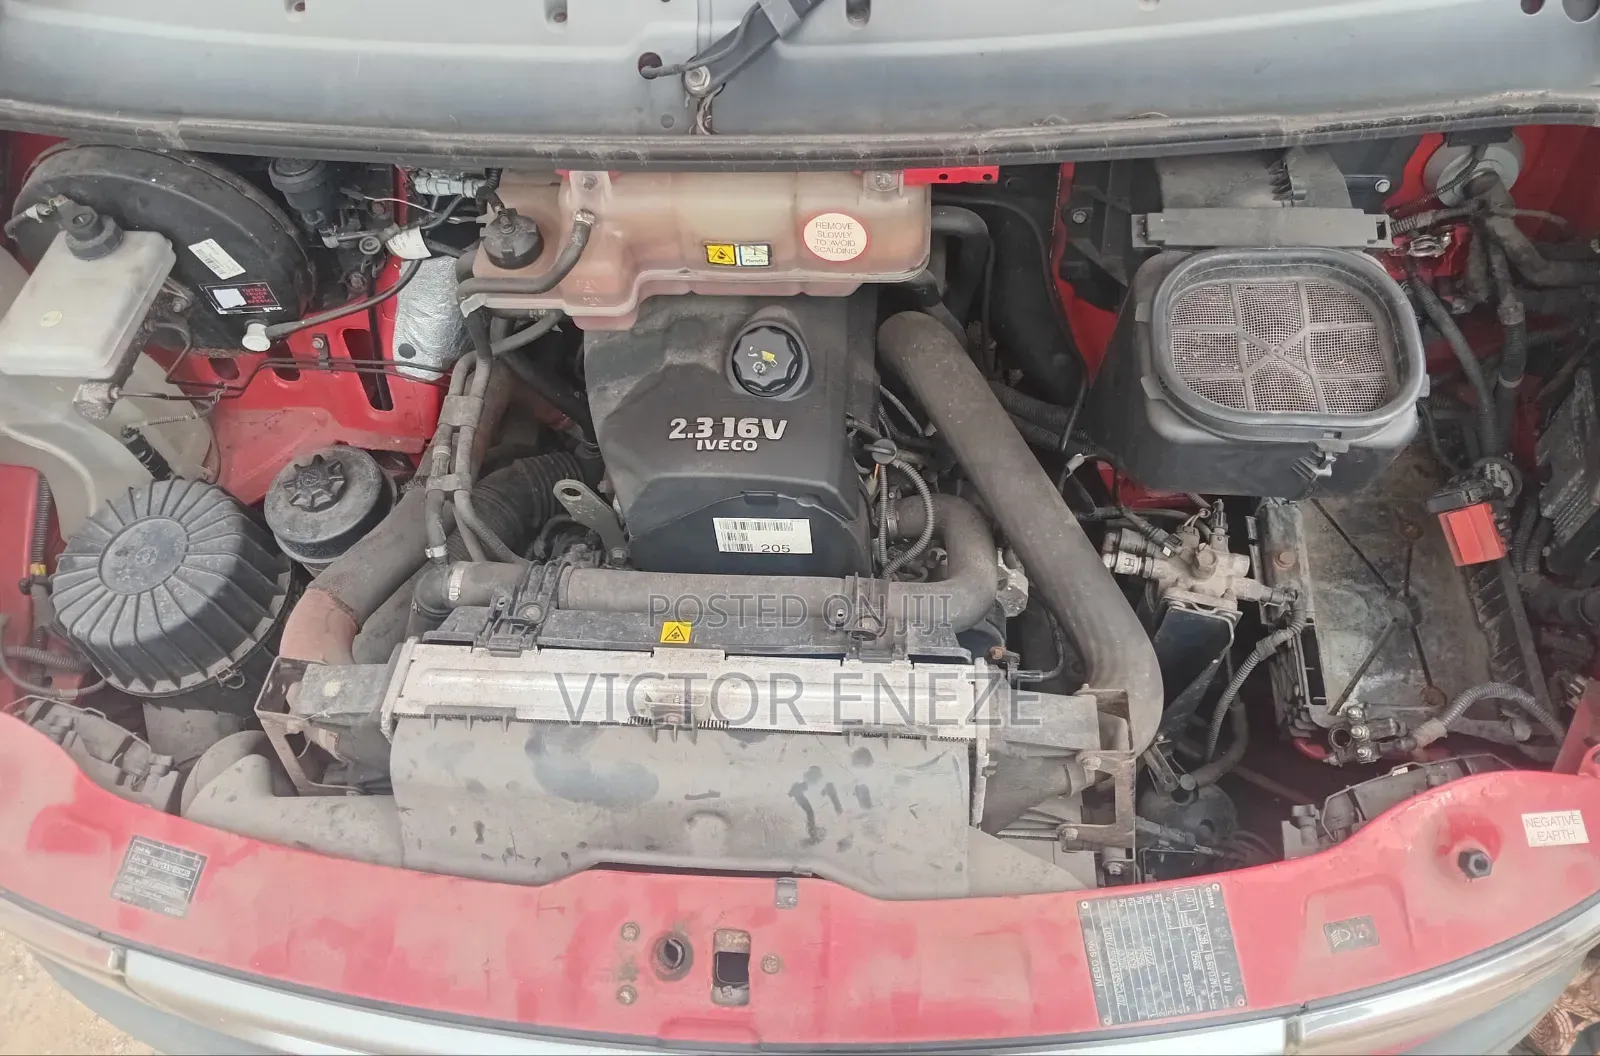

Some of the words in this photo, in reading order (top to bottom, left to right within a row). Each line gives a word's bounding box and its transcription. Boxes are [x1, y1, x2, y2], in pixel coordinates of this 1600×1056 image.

[816, 222, 854, 230] REMOVE
[817, 230, 852, 238] SLOWLY
[816, 238, 826, 246] TO
[814, 246, 857, 254] SCALDING
[669, 416, 714, 440] 2.3
[722, 417, 788, 440] 16V
[696, 439, 758, 451] IVECO
[760, 544, 790, 553] 205
[1525, 812, 1580, 828] NEGATIVE
[1537, 829, 1576, 842] EARTH
[1204, 886, 1215, 908] IVECO
[1091, 959, 1103, 987] IVECO
[1221, 970, 1233, 991] ITALY
